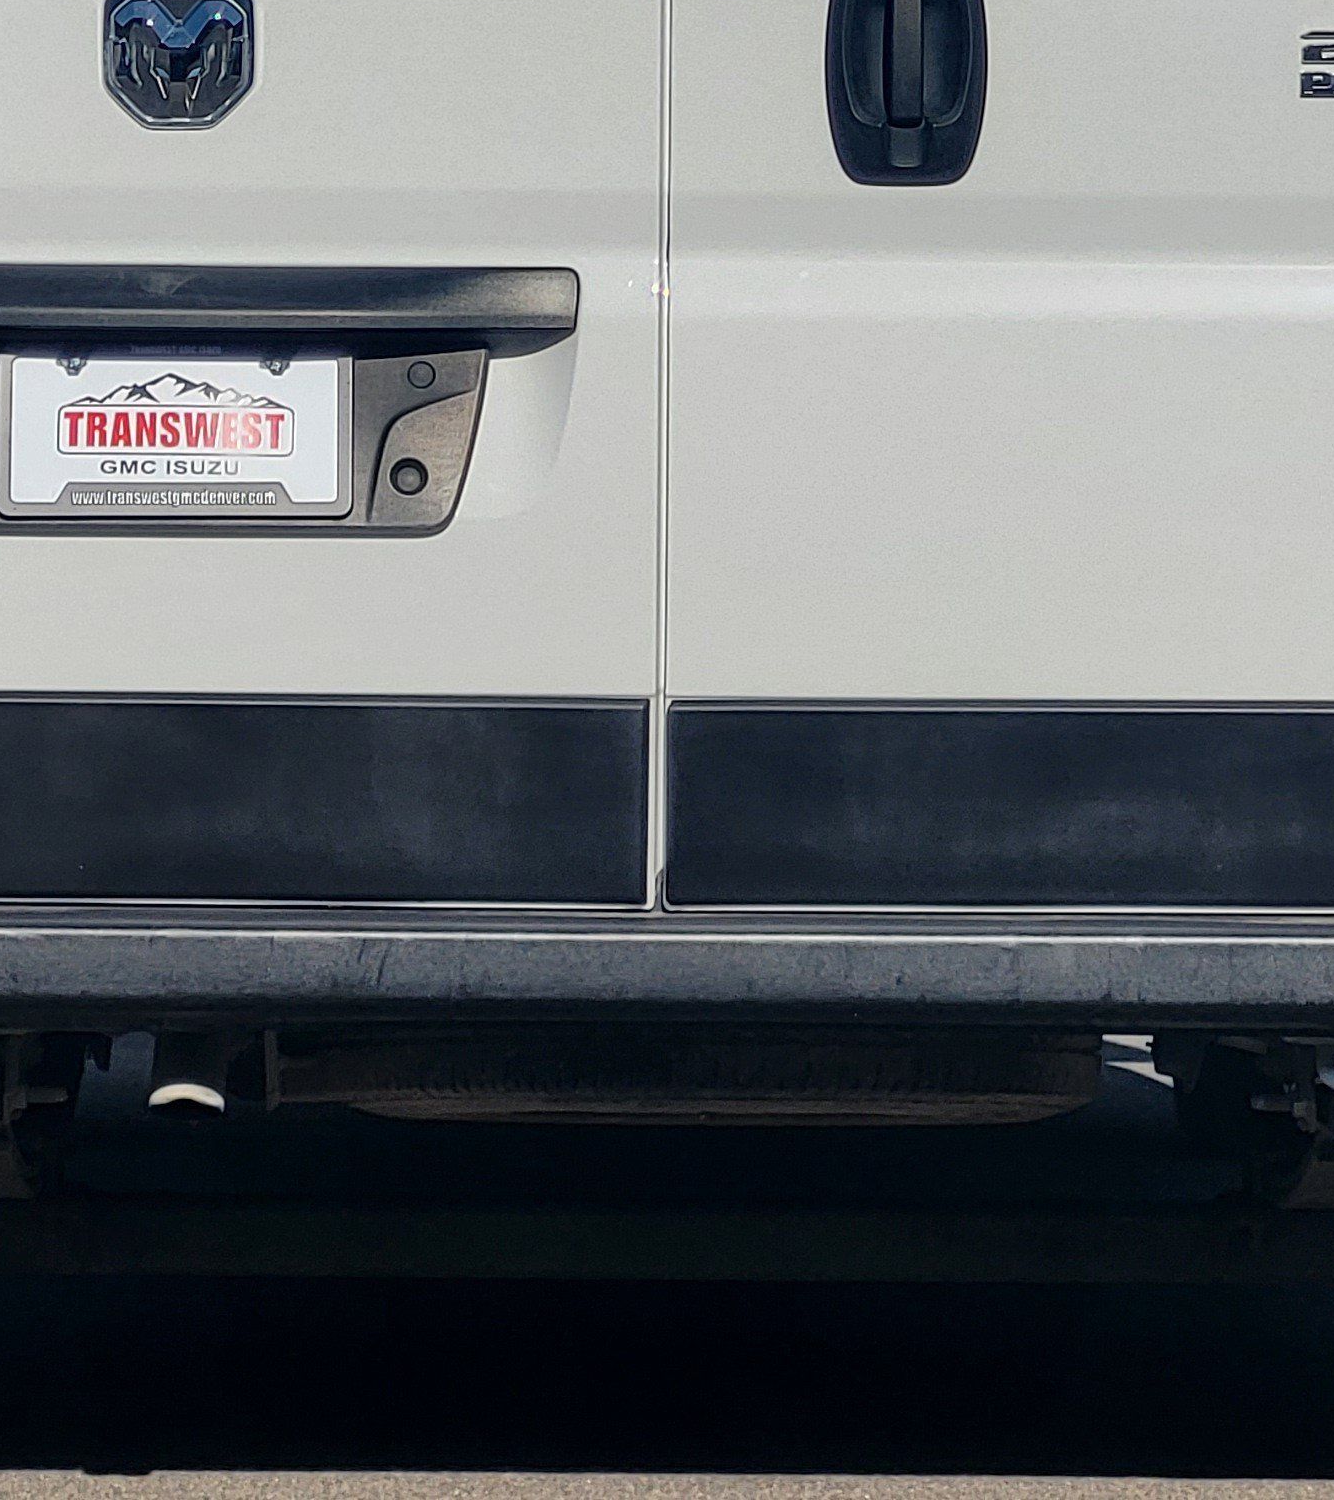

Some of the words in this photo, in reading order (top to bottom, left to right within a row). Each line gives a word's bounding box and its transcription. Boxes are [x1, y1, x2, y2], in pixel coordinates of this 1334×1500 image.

[63, 411, 286, 450] TRANSWEST
[100, 459, 157, 476] GMC
[166, 459, 240, 476] ISUZU
